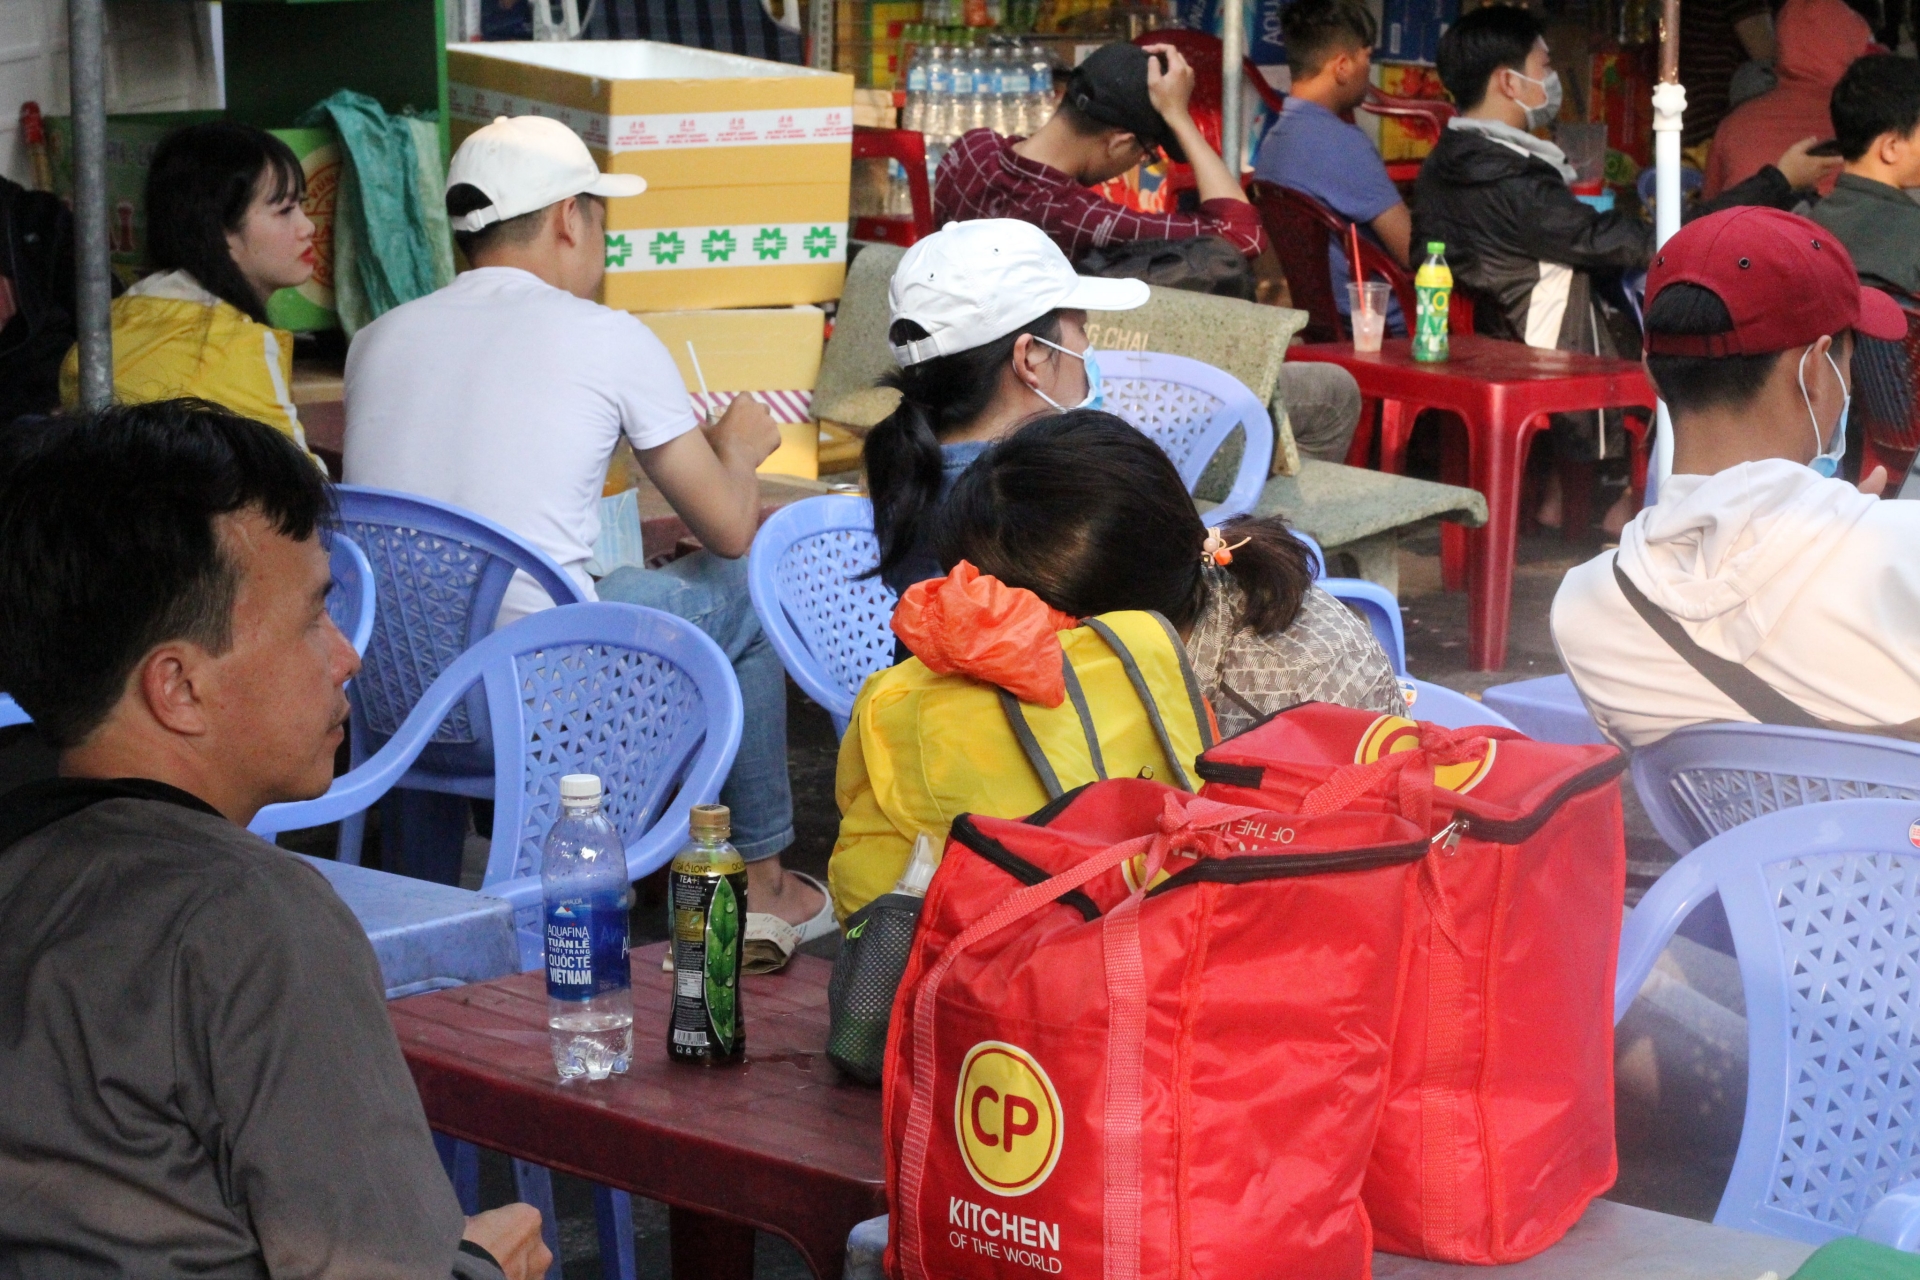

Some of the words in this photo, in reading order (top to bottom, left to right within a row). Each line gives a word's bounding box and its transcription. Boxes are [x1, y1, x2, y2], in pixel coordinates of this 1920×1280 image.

[1235, 819, 1267, 839] THE
[1270, 827, 1295, 844] OF
[691, 864, 712, 874] LONG
[547, 923, 591, 940] AQUAFINA
[971, 1084, 1039, 1153] CP
[949, 1196, 1060, 1252] KITCHEN
[949, 1231, 968, 1250] OF
[971, 1237, 1000, 1259] THE
[1003, 1245, 1063, 1274] WORLD
